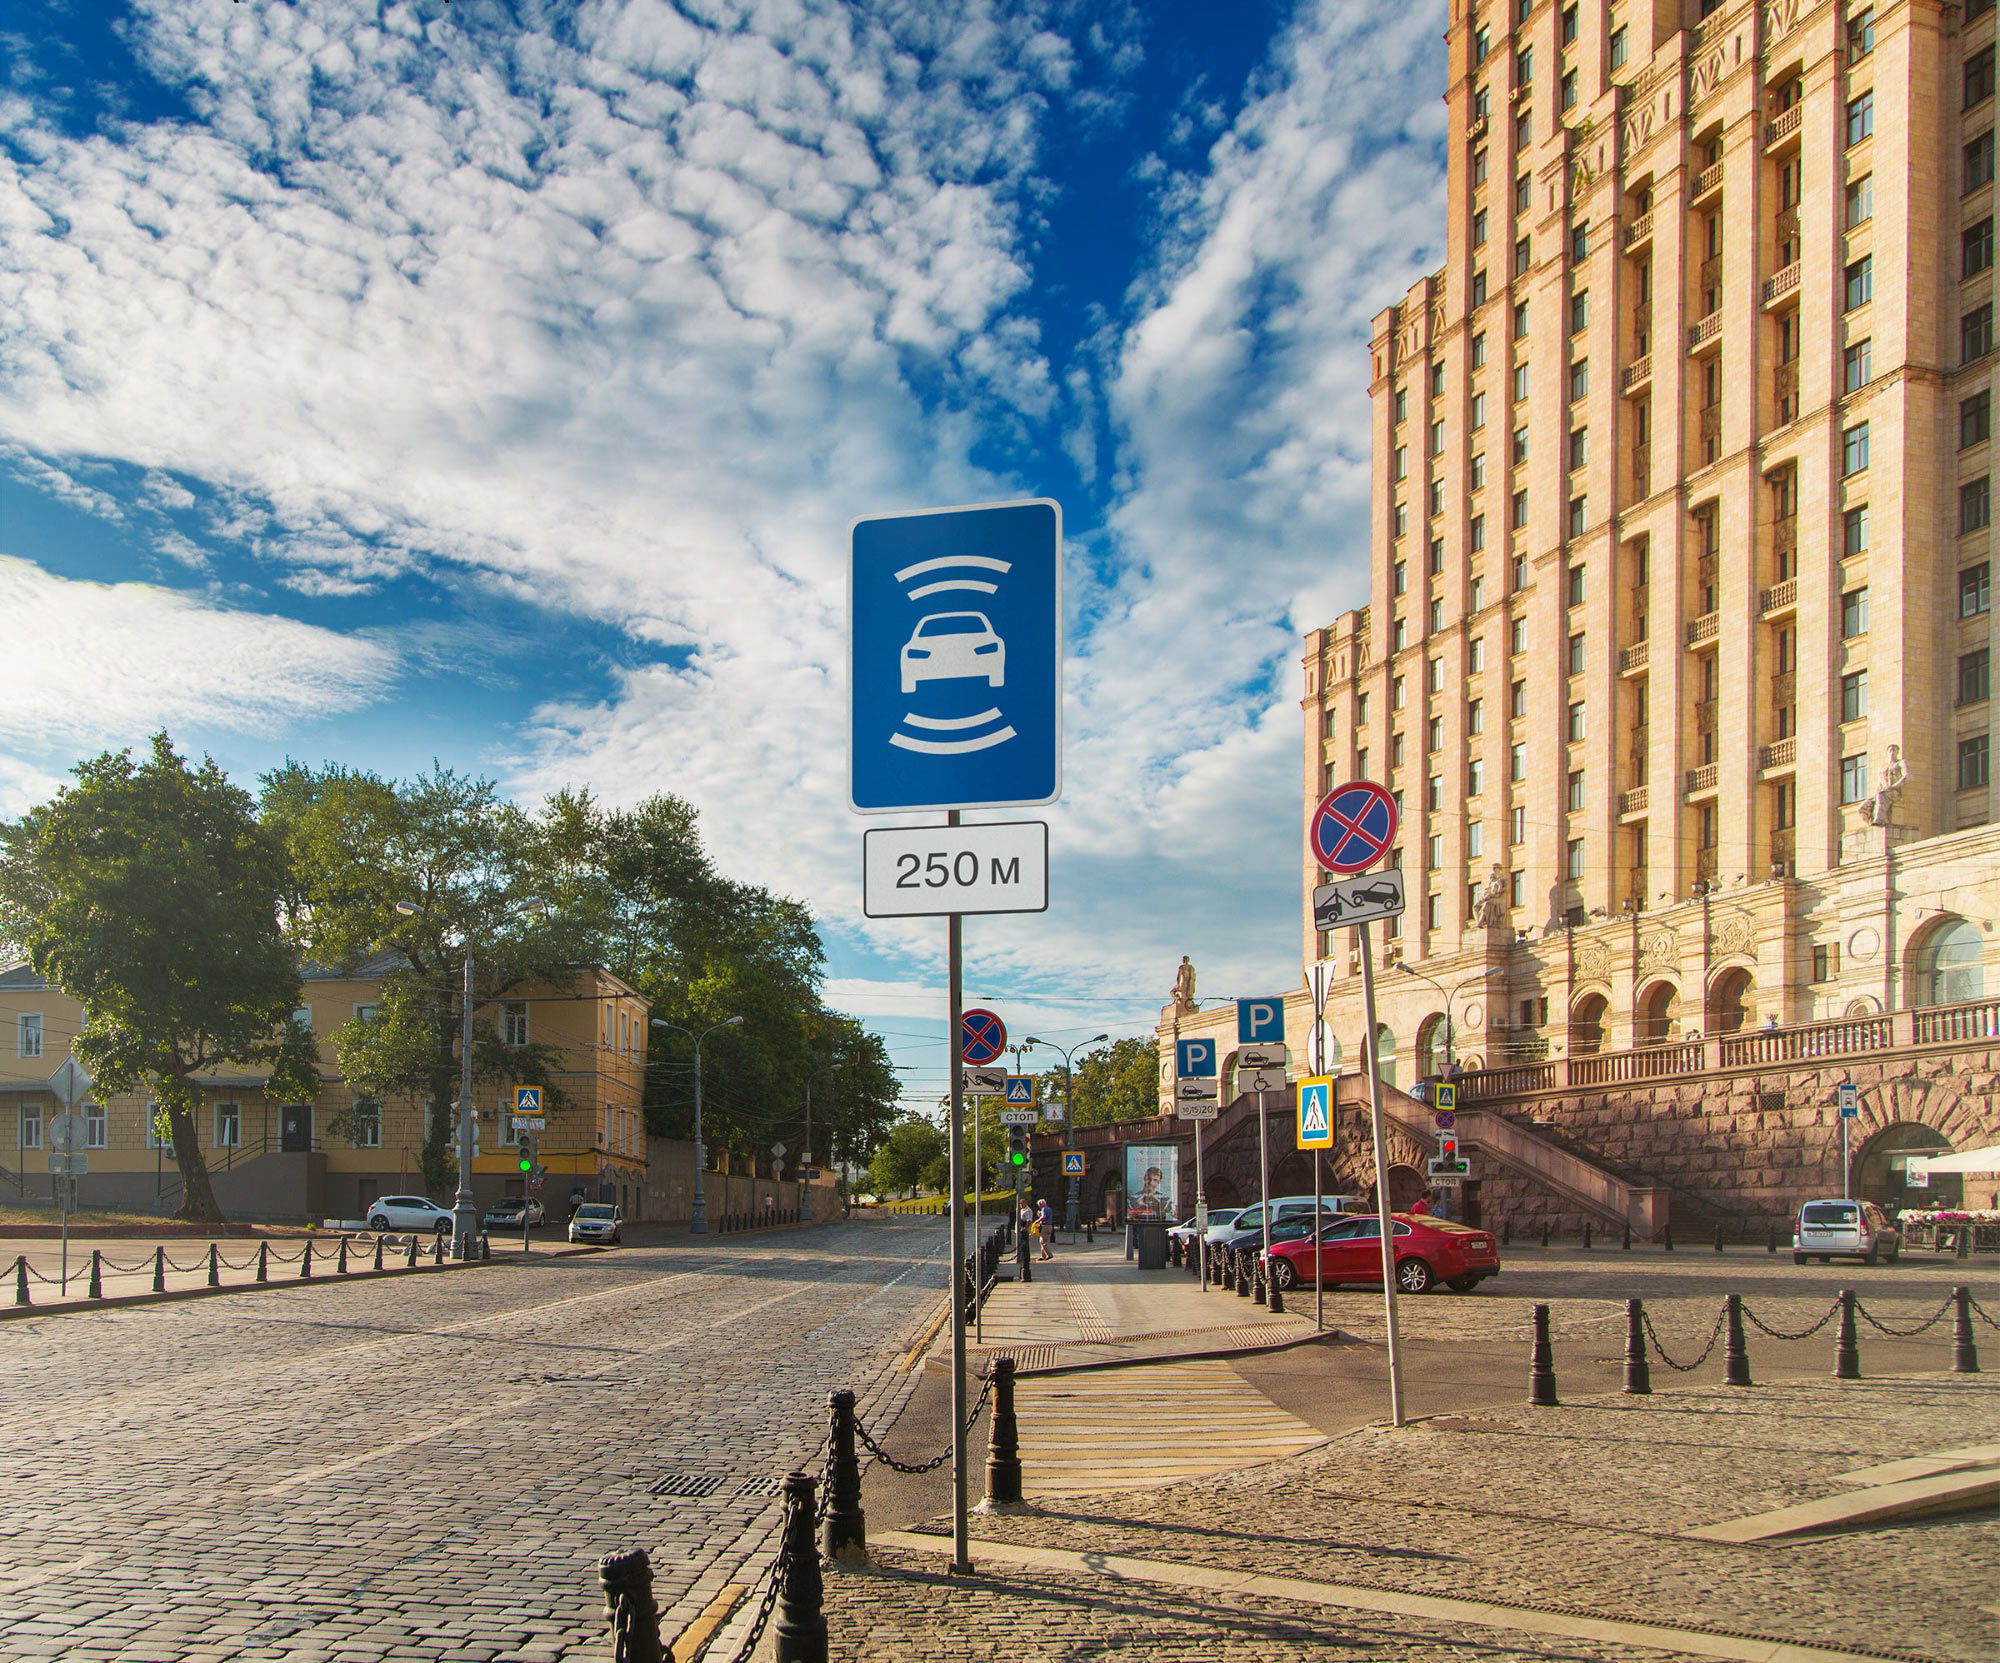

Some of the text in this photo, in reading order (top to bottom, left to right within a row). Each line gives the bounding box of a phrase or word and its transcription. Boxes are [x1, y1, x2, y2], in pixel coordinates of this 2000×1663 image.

[896, 851, 979, 888] 250
[1250, 1004, 1274, 1038] P
[1186, 1044, 1207, 1073] P
[1006, 1113, 1033, 1121] СТОП
[1201, 1105, 1213, 1114] 20
